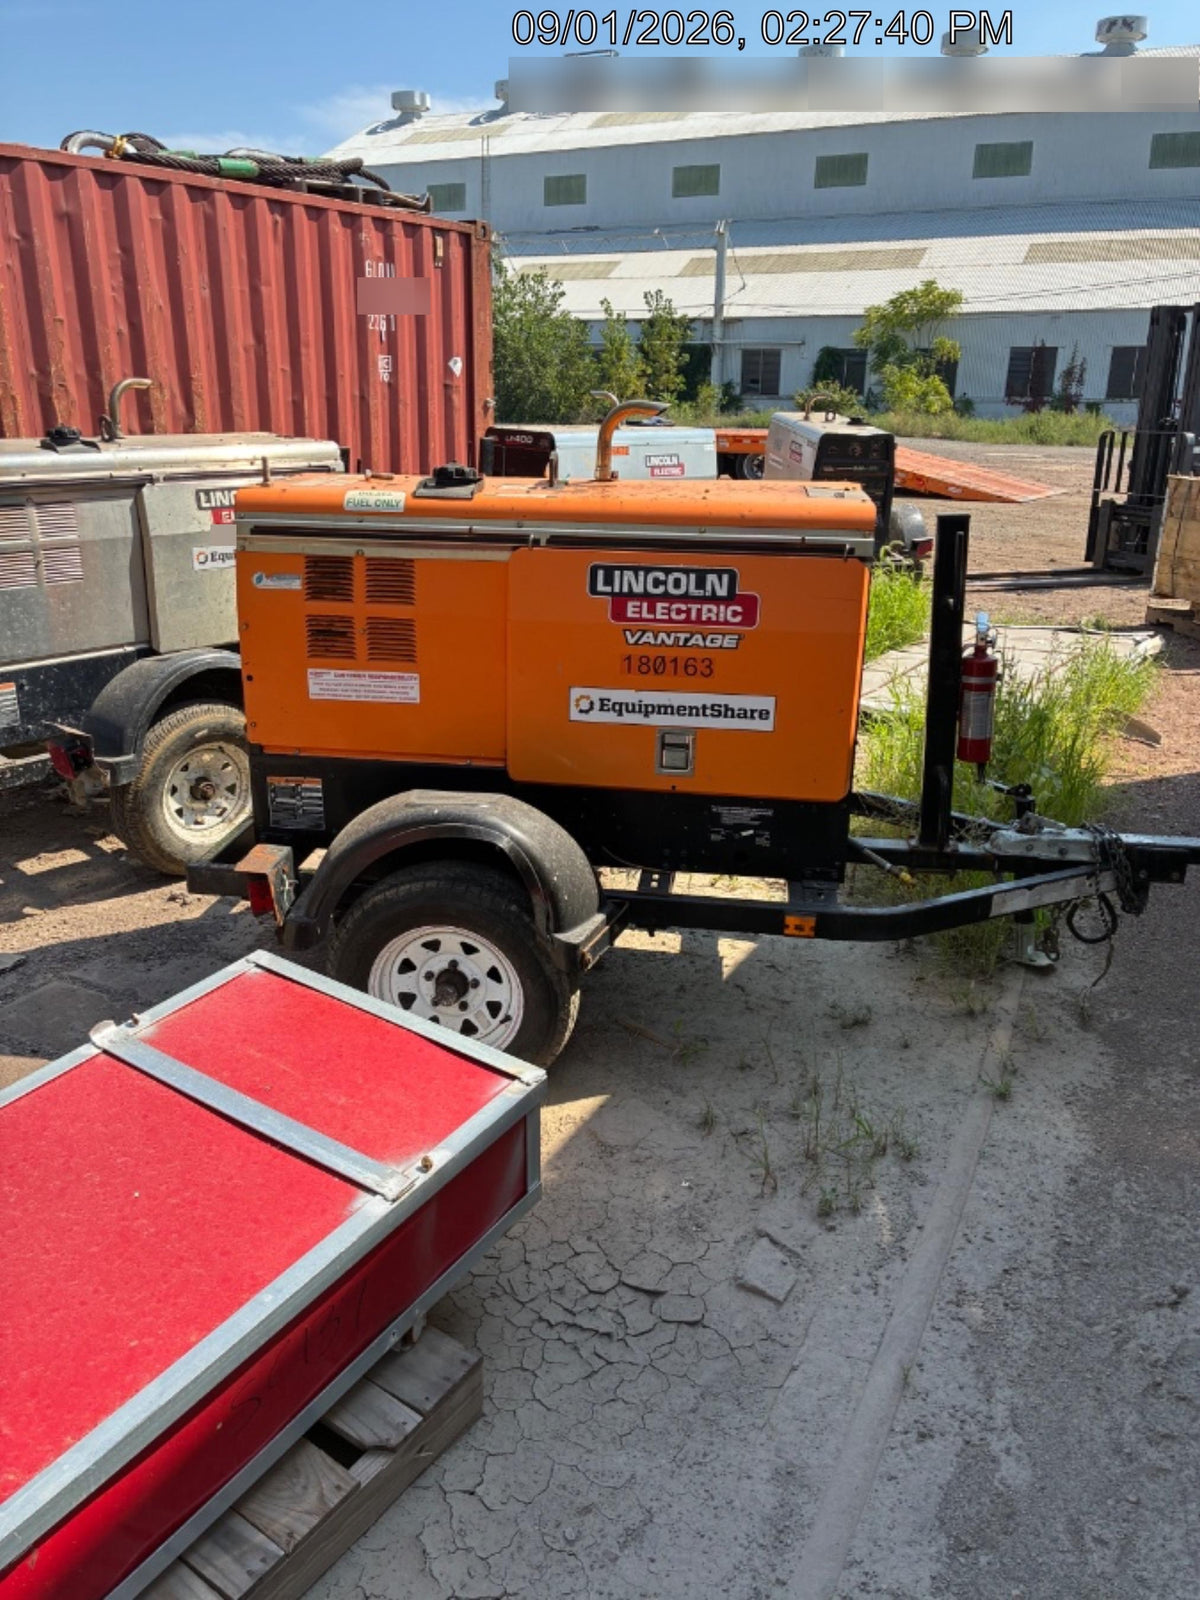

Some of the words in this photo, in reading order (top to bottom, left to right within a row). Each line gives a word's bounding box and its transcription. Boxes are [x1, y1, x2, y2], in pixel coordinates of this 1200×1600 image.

[346, 498, 371, 507] FUEL
[375, 499, 402, 508] ONLY
[596, 569, 730, 597] LINCOLN
[626, 601, 744, 623] ELECTRIC
[623, 629, 740, 648] VANTAGE
[623, 654, 715, 677] 180163
[598, 698, 770, 721] EquipmentShare
